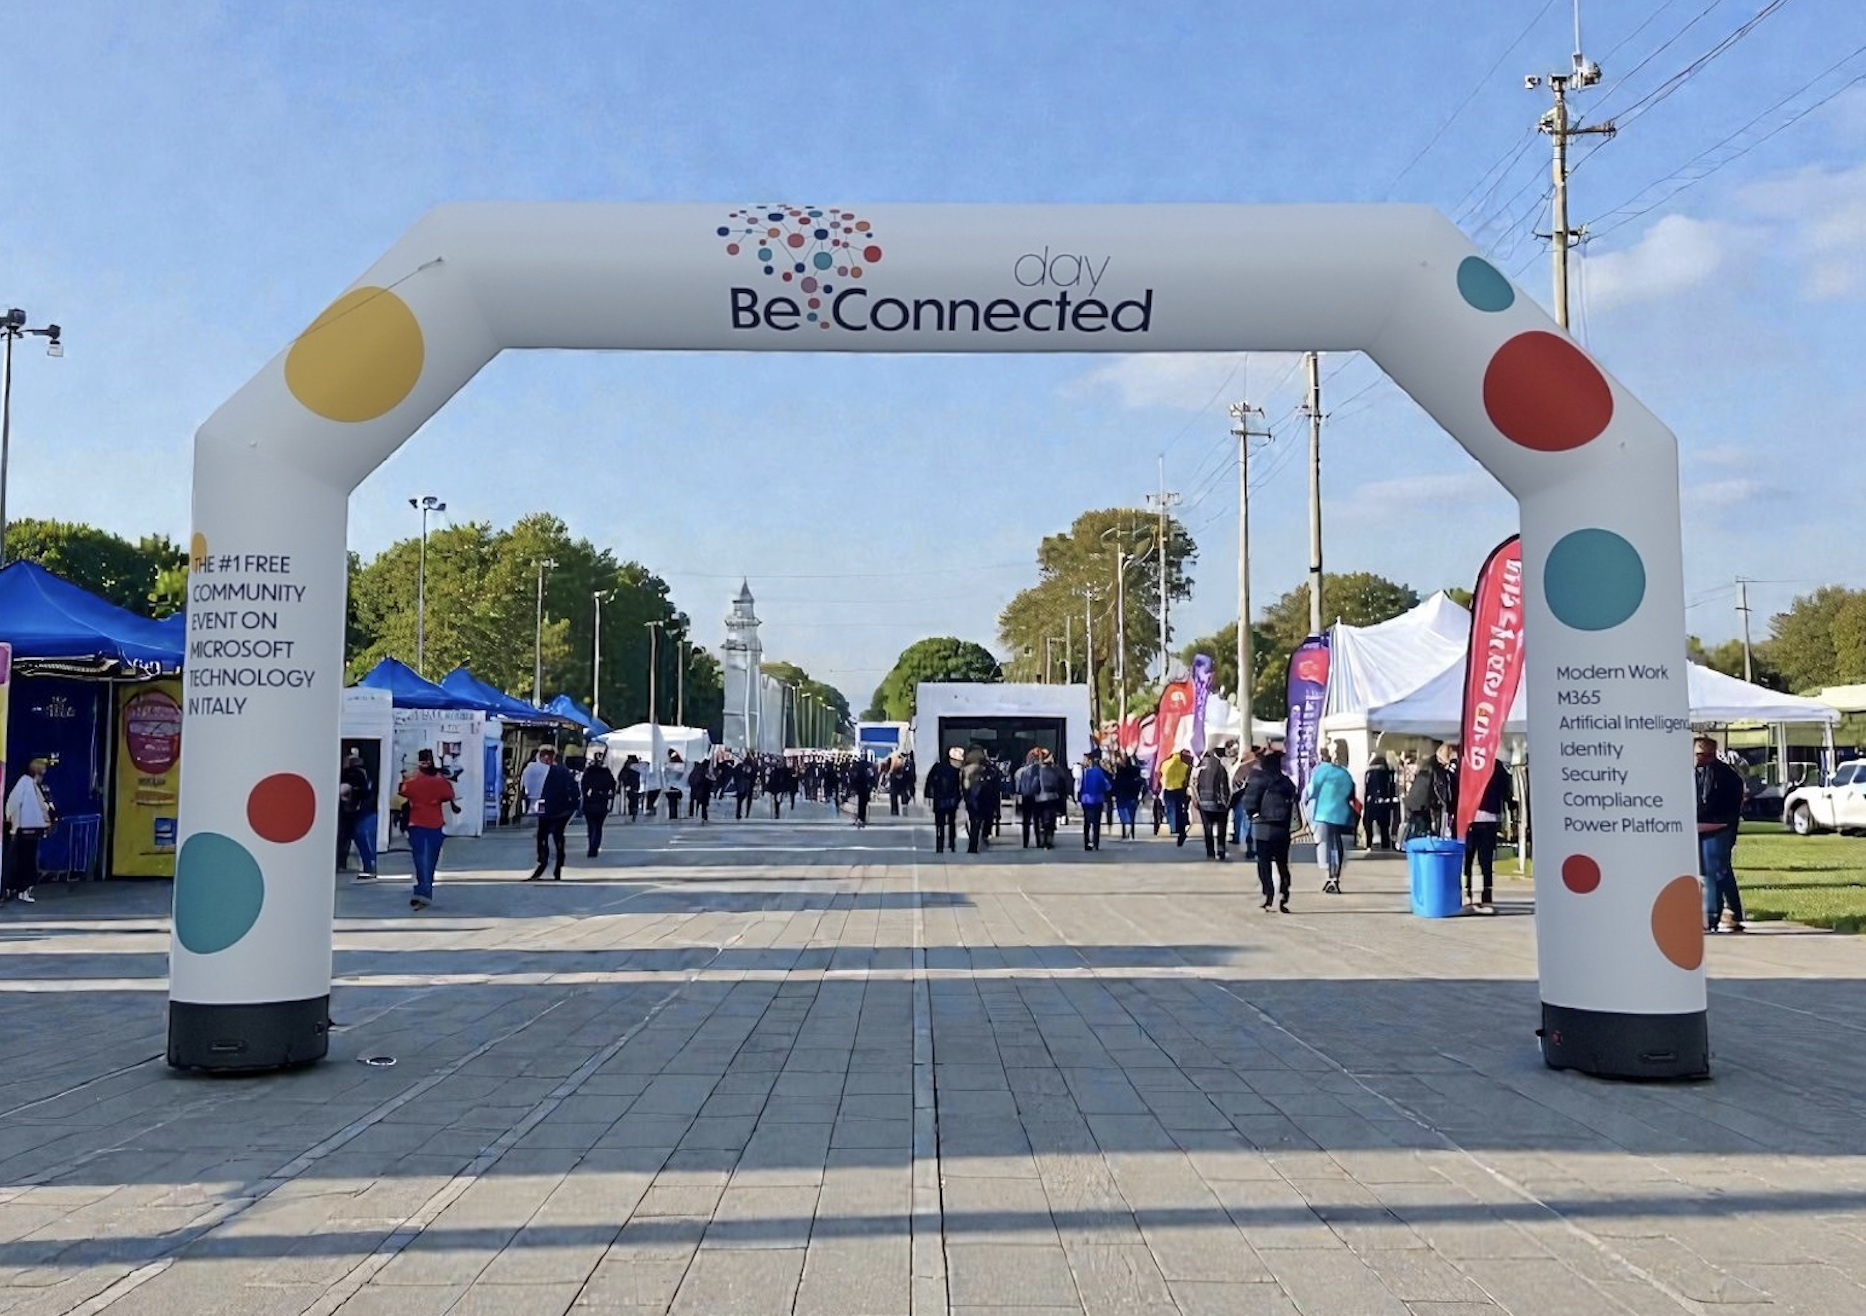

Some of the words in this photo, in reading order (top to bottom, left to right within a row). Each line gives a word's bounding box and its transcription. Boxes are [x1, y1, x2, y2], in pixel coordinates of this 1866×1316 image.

[1013, 245, 1111, 297] day
[730, 286, 802, 331] Be
[831, 286, 1154, 333] Connected
[194, 554, 216, 574] THE
[218, 554, 240, 573] #1
[244, 554, 291, 574] FREE
[192, 582, 306, 603] COMMUNITY
[191, 611, 238, 631] EVENT
[241, 611, 278, 630] ON
[189, 639, 295, 660] MICROSOFT
[189, 668, 316, 689] TECHNOLOGY
[1556, 664, 1626, 681] Modern
[1628, 664, 1670, 681] Work
[200, 696, 248, 716] ITALY
[1557, 689, 1602, 705] M365
[1559, 715, 1622, 731] Artificial
[1560, 741, 1624, 760] Identity
[1561, 766, 1629, 786] Security
[1562, 791, 1664, 811] Compliance
[1564, 817, 1619, 833] Power
[1622, 817, 1684, 834] Platform
